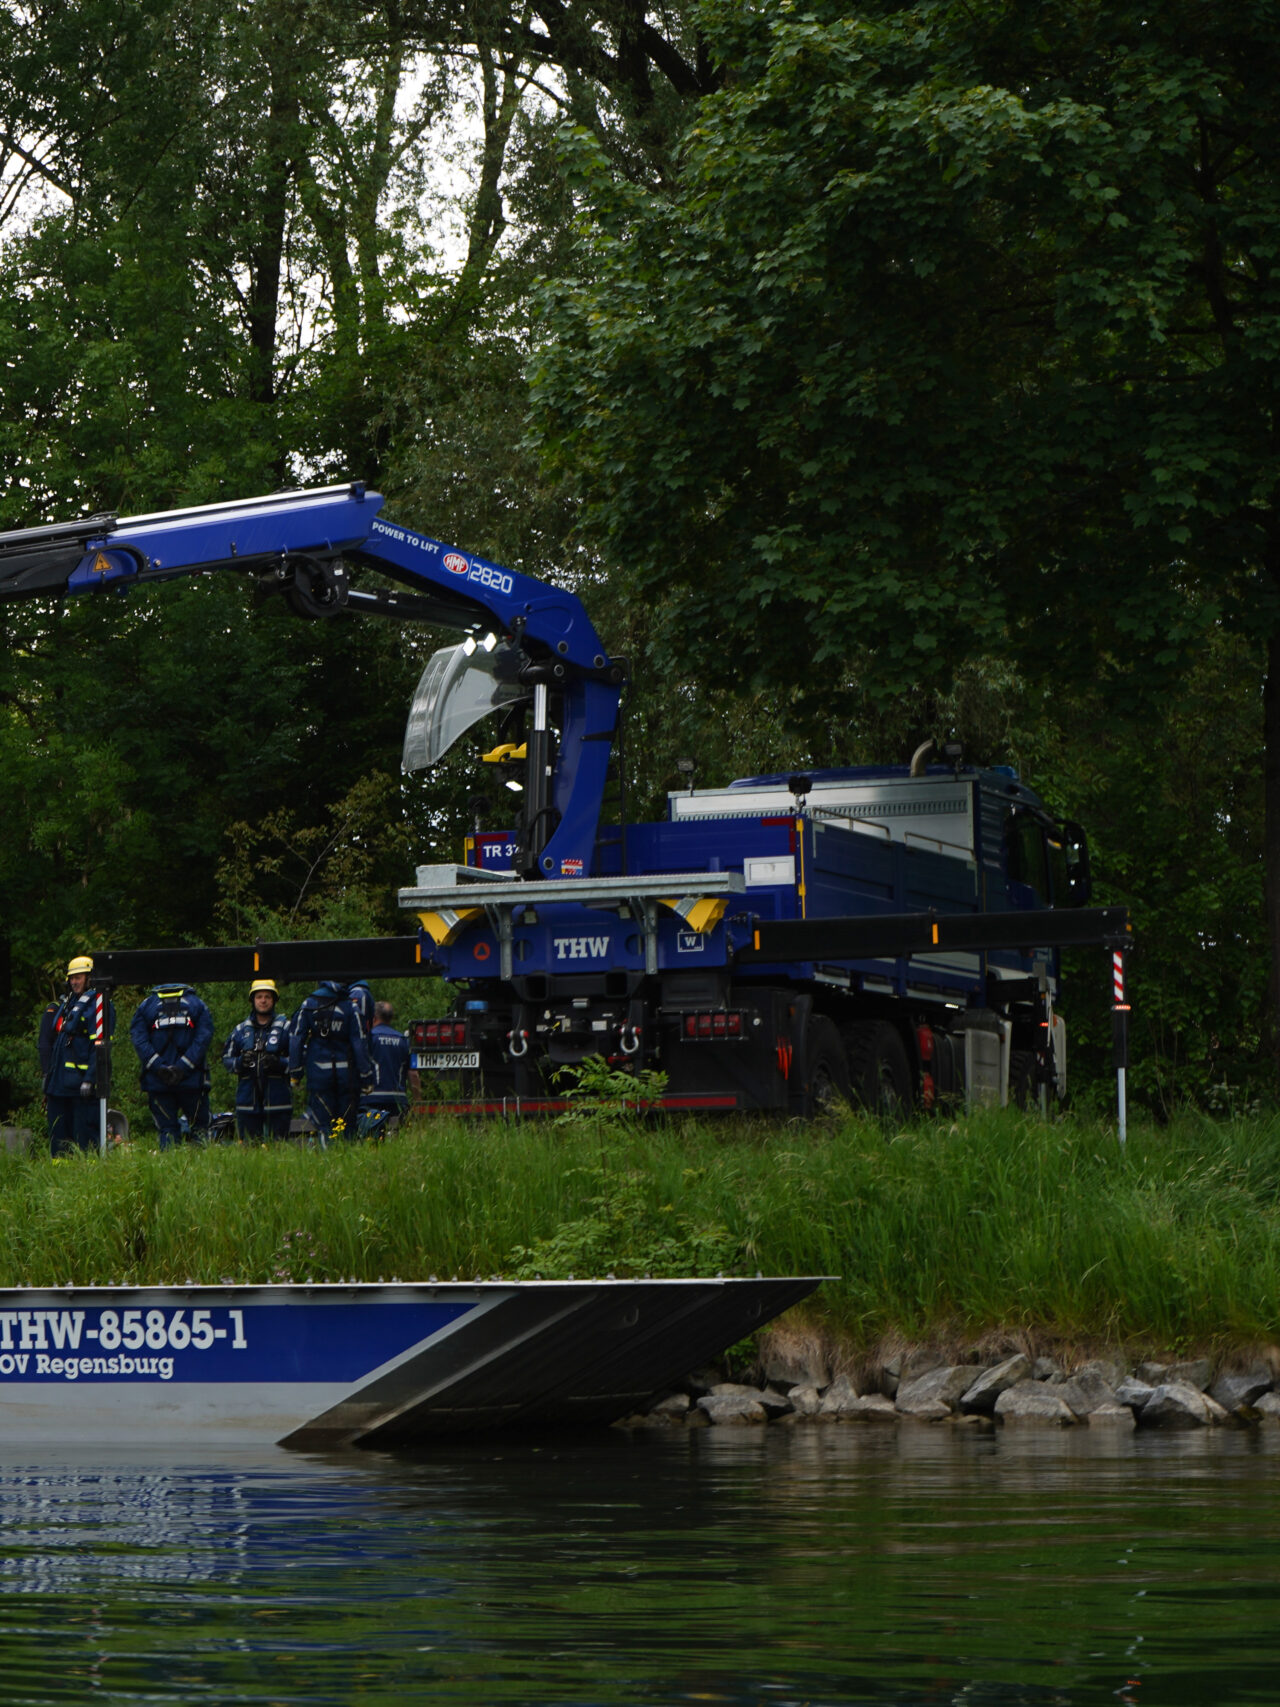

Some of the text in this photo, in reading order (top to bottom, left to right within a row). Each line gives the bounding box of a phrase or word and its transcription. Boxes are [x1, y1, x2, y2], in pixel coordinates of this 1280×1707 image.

[372, 521, 439, 554] POWER TO LIFT
[446, 556, 464, 571] HMF
[470, 562, 513, 594] 2820
[483, 845, 502, 858] TR
[554, 937, 610, 959] THW
[684, 936, 697, 947] W
[378, 1036, 400, 1046] THW
[418, 1054, 477, 1067] THW 99610
[36, 1354, 175, 1380] Regensburg
